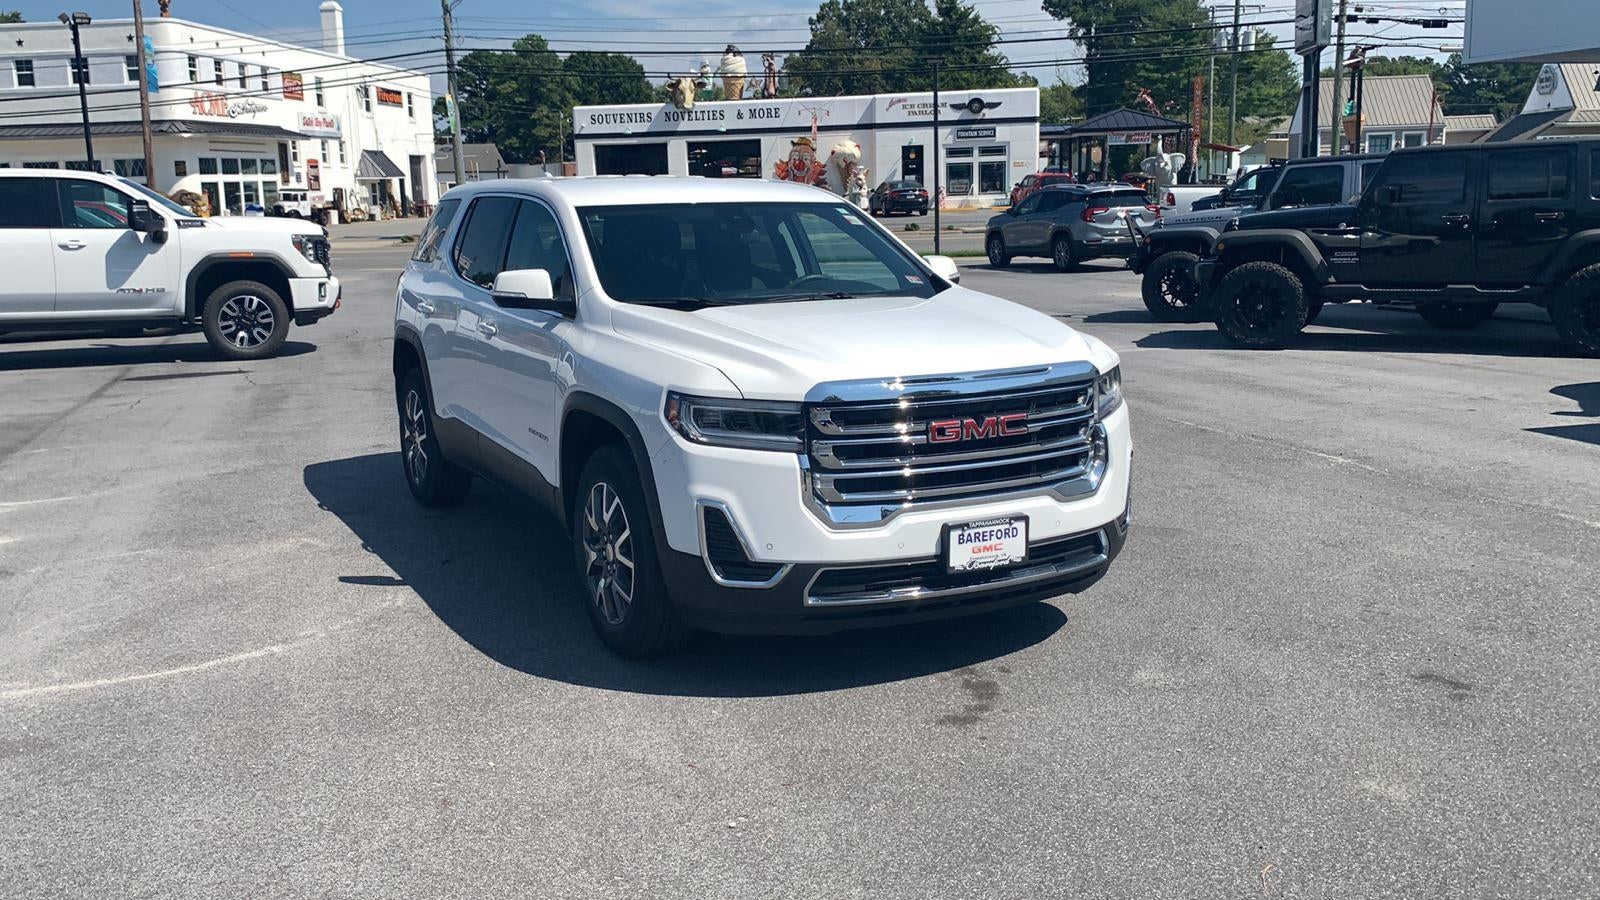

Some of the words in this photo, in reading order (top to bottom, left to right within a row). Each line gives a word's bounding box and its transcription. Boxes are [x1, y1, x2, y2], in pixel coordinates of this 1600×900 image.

[190, 91, 229, 117] ACME
[590, 112, 652, 125] SOUVENIRS
[664, 110, 725, 122] NOVELTIES
[736, 109, 744, 120] &
[749, 107, 780, 119] MORE
[957, 130, 977, 138] FOUNTAIN
[929, 413, 1028, 443] GMC
[968, 517, 1010, 528] TAPPAHANNOCK
[957, 526, 1019, 545] BAREFORD
[971, 542, 1004, 554] GMC
